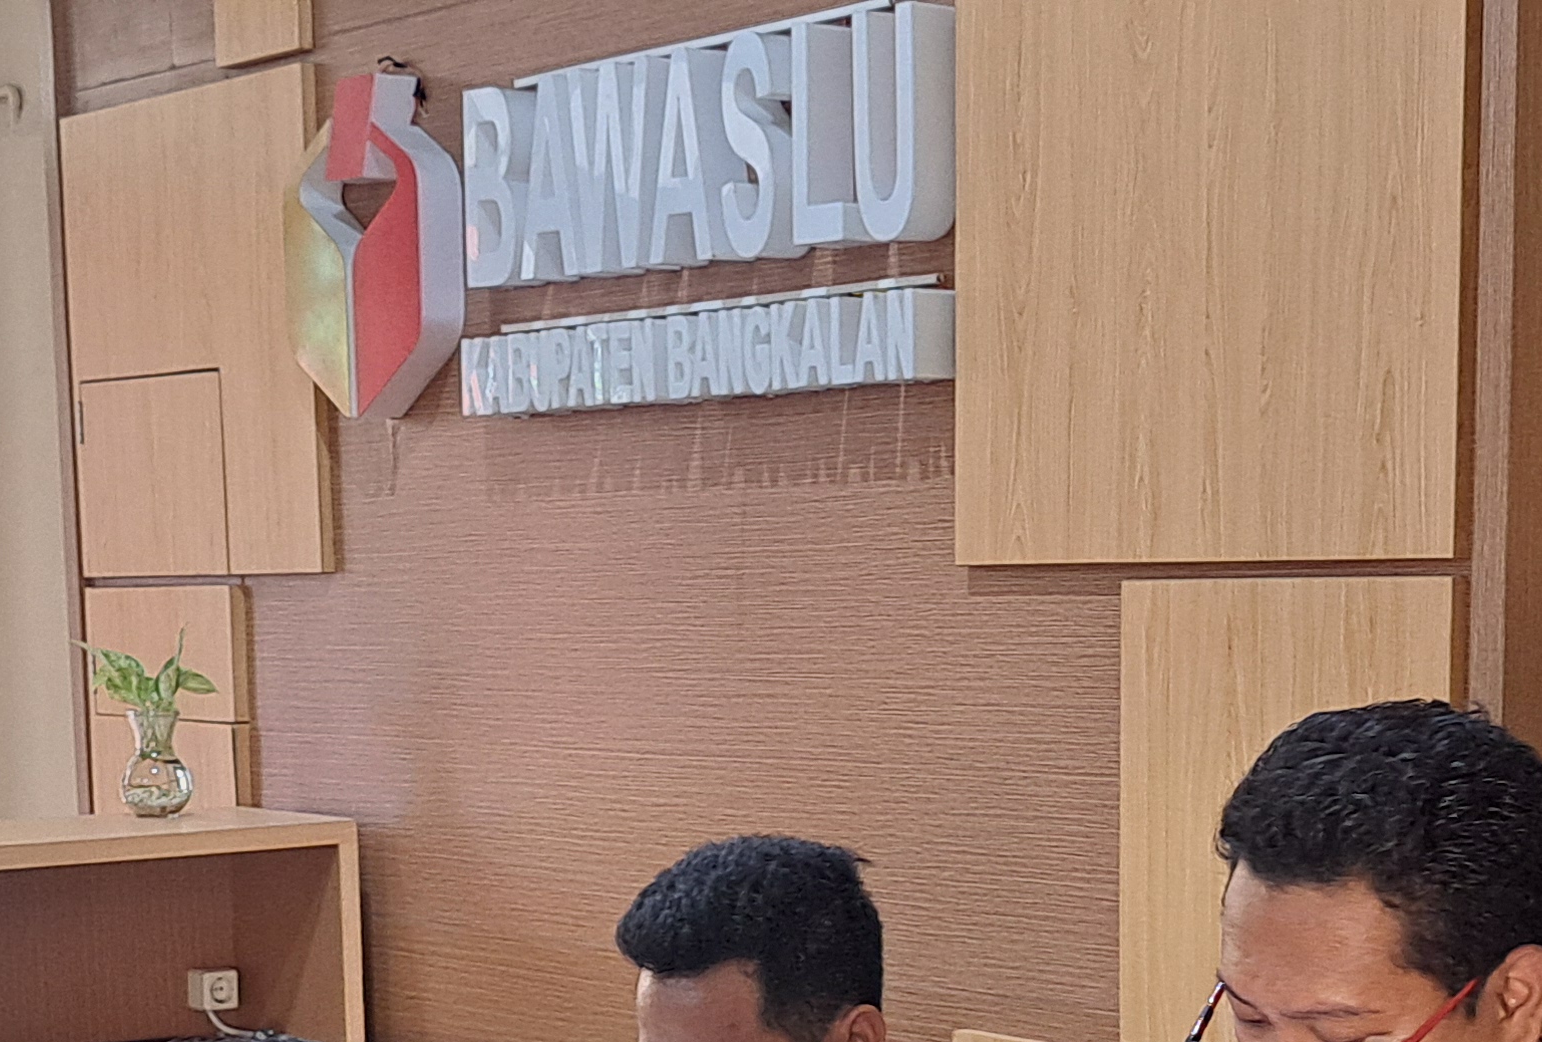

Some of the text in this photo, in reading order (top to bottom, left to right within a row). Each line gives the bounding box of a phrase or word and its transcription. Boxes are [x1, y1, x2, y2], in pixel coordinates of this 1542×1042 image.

[462, 1, 917, 289] BAWASLU
[461, 288, 917, 416] KABUPATEN BANGKALAN
